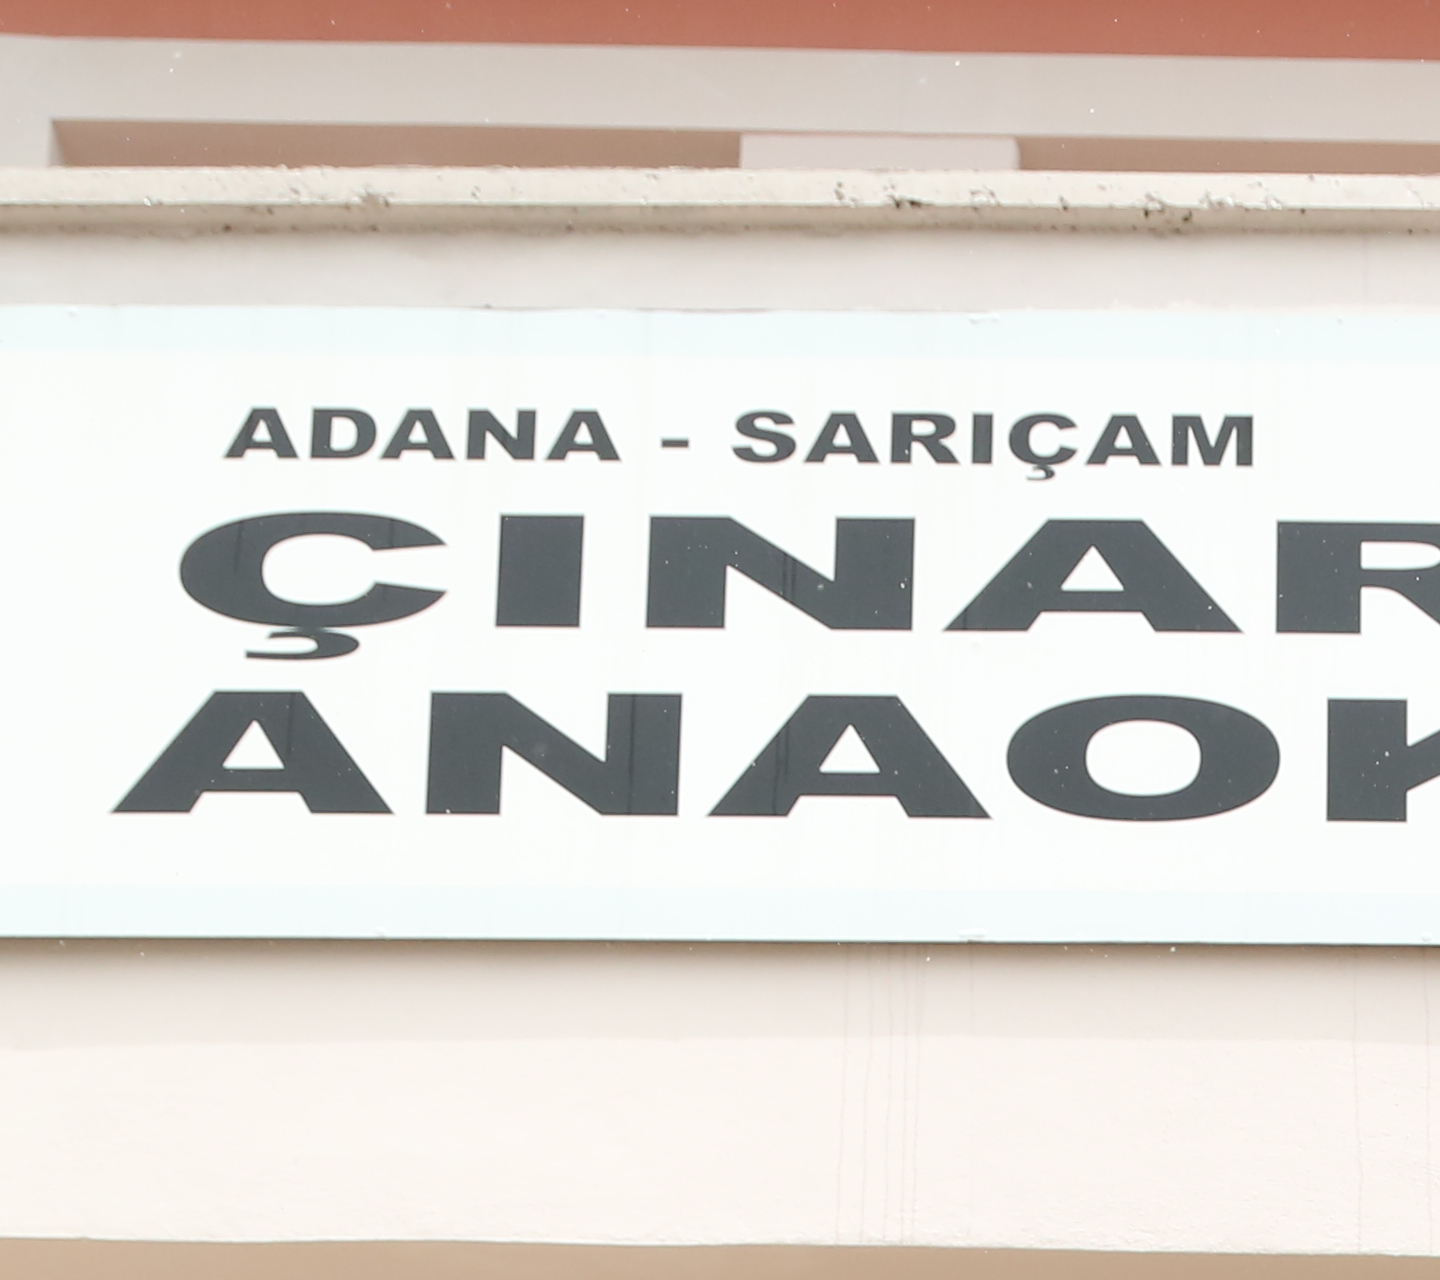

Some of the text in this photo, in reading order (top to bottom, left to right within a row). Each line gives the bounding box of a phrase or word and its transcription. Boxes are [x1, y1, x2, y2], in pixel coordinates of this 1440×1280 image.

[225, 408, 1253, 480] ADANA - SARIÇAM
